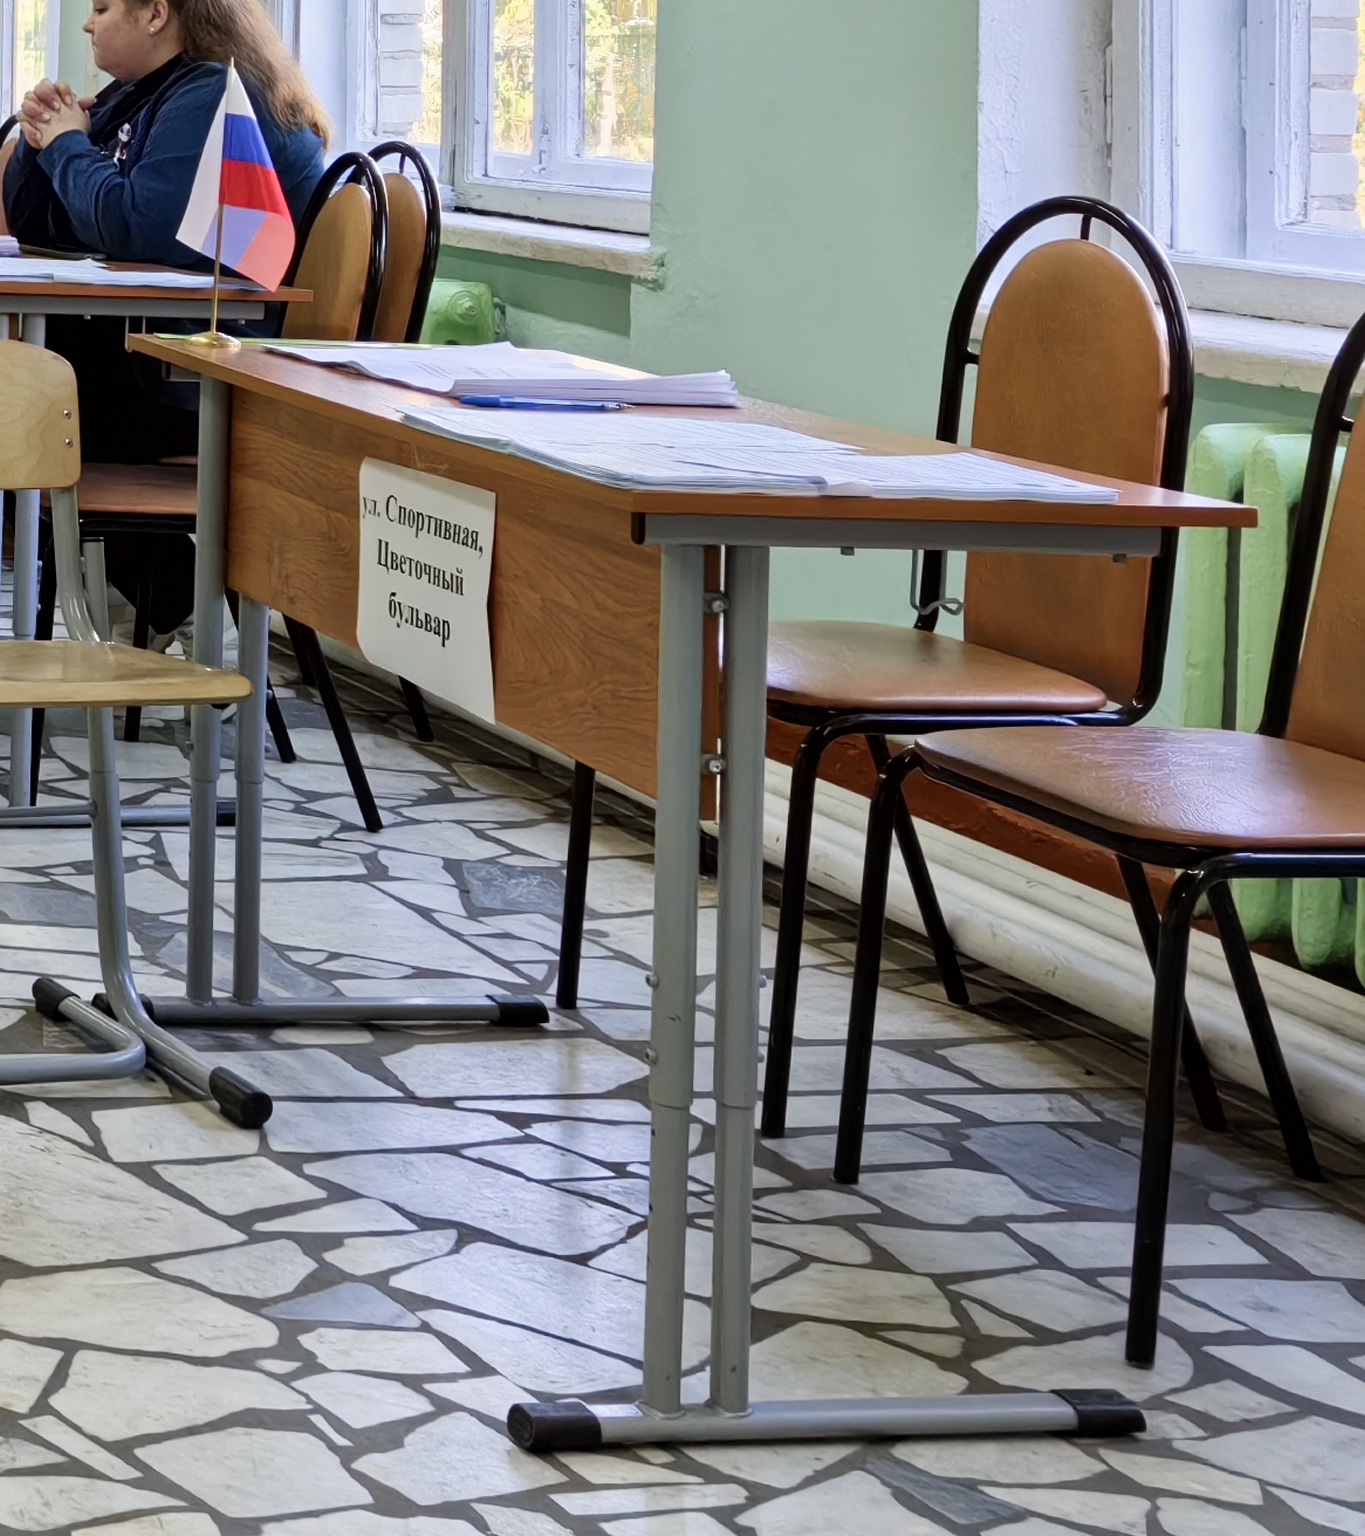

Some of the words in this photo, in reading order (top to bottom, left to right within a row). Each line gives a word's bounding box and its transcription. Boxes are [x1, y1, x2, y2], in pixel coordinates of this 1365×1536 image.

[362, 495, 381, 519] ул.
[386, 495, 483, 558] Спортивная,
[377, 538, 464, 596] Цветочный
[388, 592, 451, 647] бульвар
